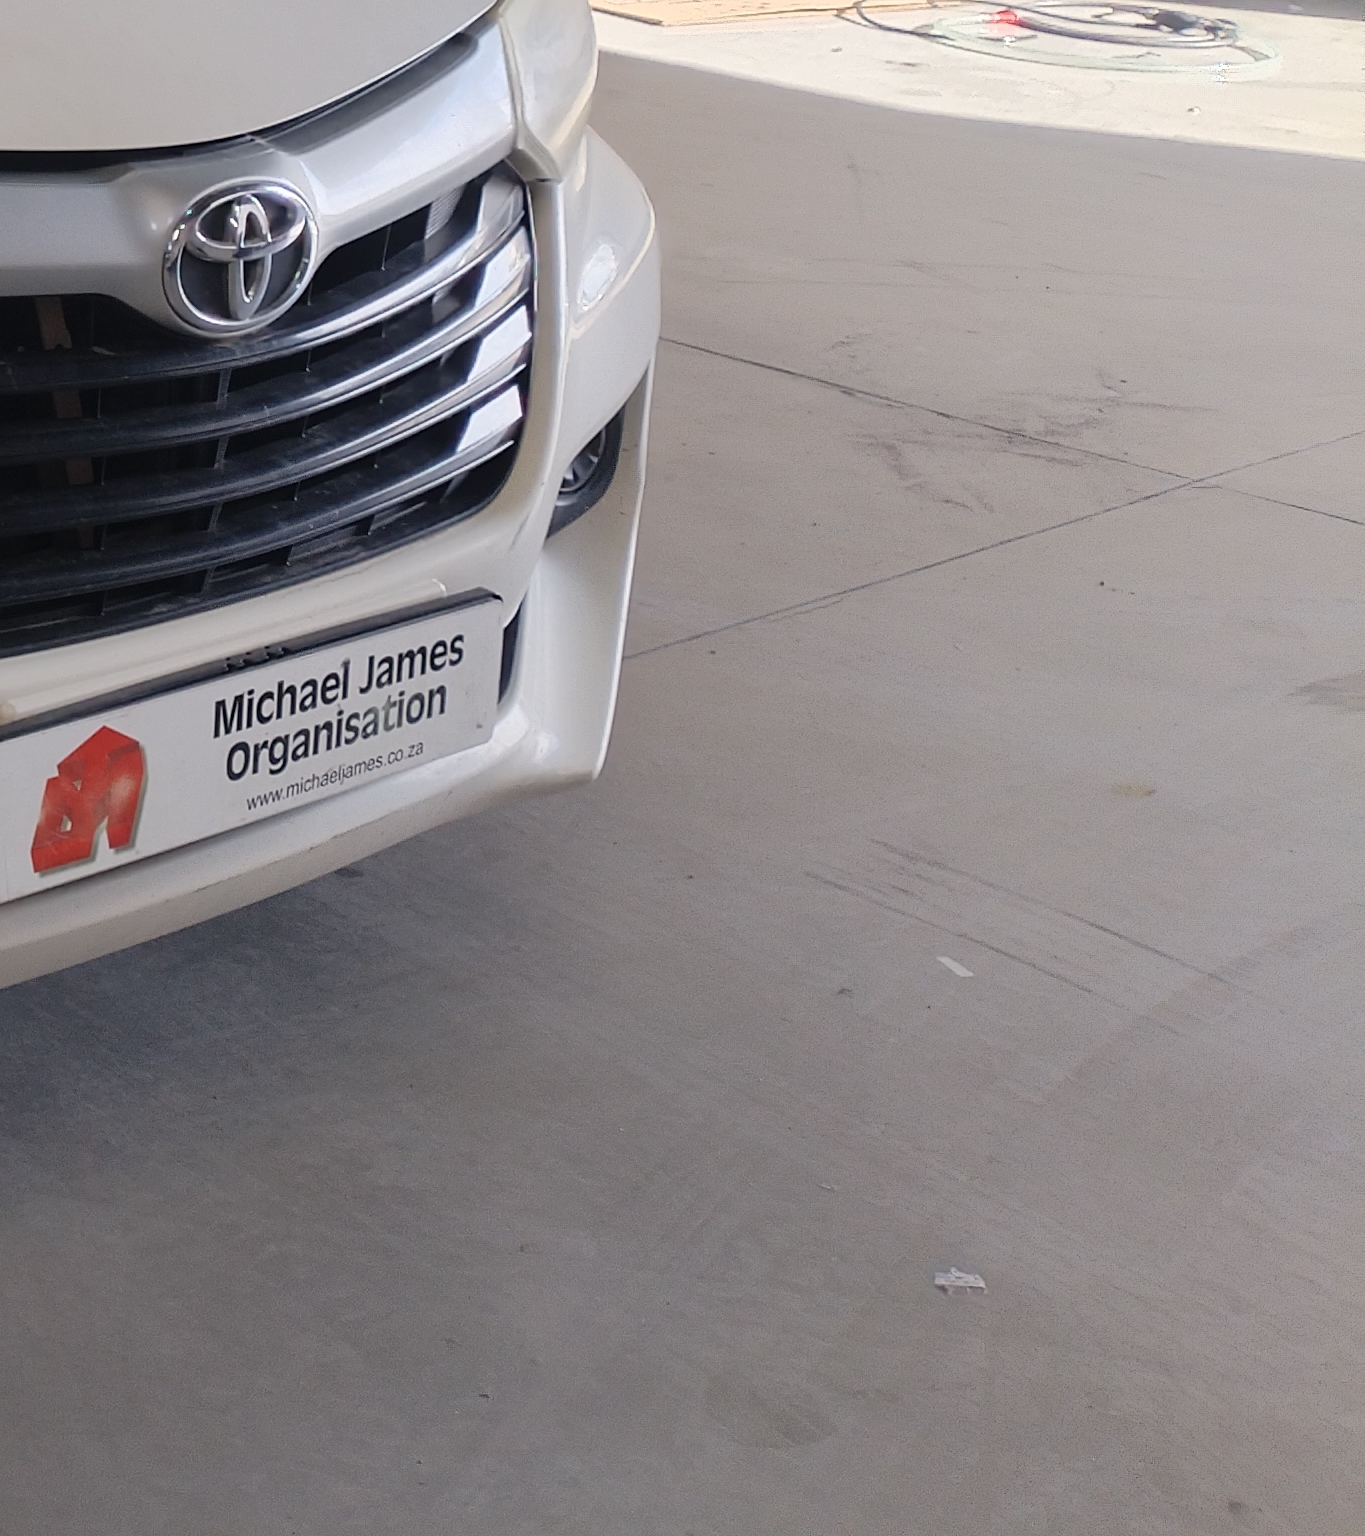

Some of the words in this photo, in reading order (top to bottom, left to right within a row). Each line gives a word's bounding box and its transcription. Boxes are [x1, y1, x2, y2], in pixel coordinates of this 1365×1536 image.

[213, 660, 350, 739] Michael
[358, 633, 465, 695] James
[226, 683, 447, 782] Organisation
[246, 740, 425, 812] www.michaeljames.co.za
